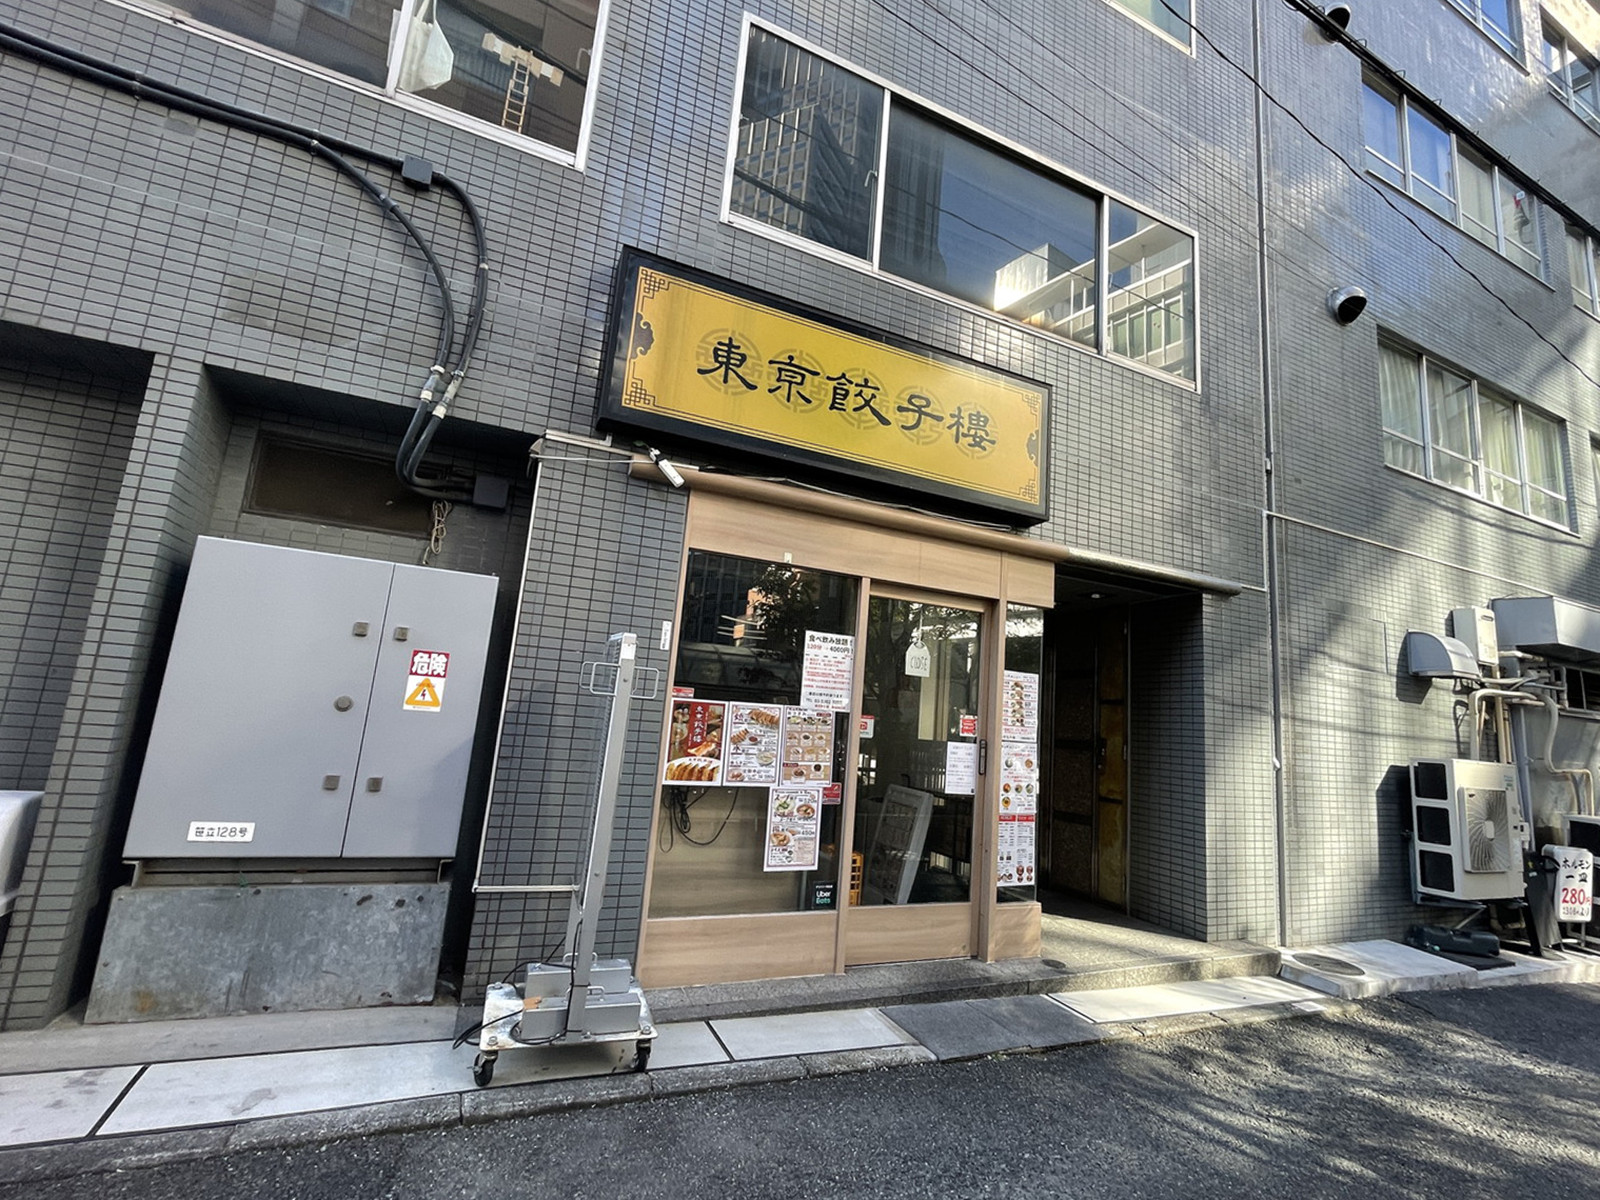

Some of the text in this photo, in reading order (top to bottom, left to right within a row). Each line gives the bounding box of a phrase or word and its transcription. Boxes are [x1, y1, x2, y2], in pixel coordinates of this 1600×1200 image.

[697, 336, 997, 452] 東京餃子樓
[412, 652, 447, 676] 危険
[1562, 858, 1591, 870] ホルモン
